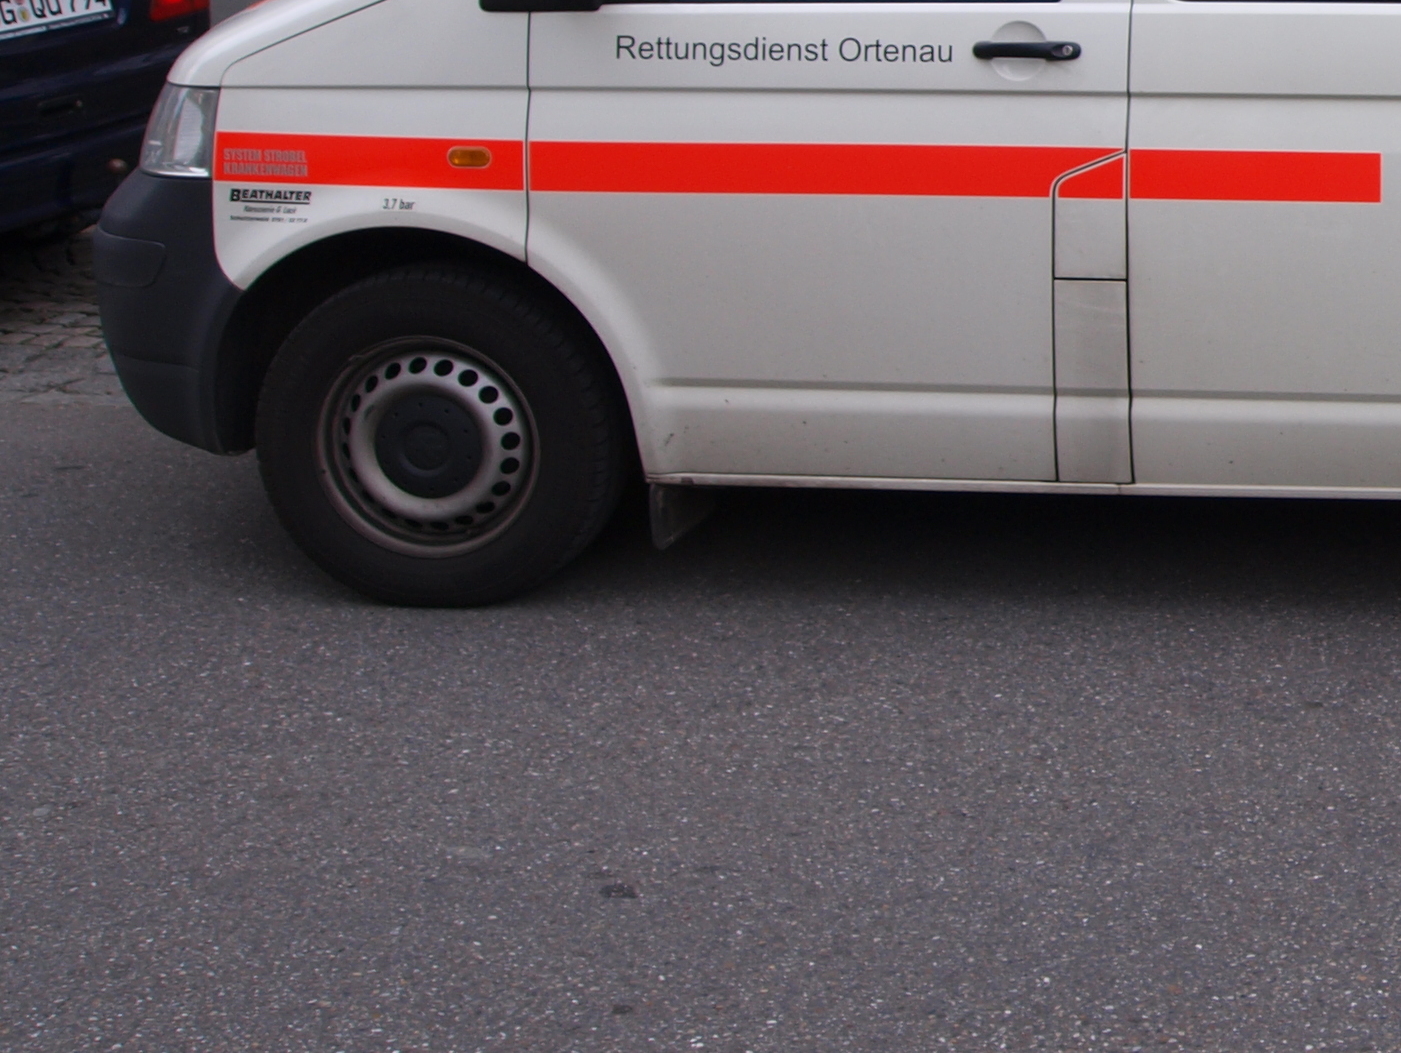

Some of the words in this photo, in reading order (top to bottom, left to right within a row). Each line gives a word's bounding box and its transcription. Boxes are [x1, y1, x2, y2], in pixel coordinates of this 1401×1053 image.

[616, 34, 828, 67] Rettungsdienst
[838, 37, 953, 63] Ortenau
[223, 148, 262, 162] SYSTEM
[223, 162, 309, 177] KRANKENWAGEN
[230, 188, 312, 203] BEATHALTER
[398, 198, 415, 210] bar
